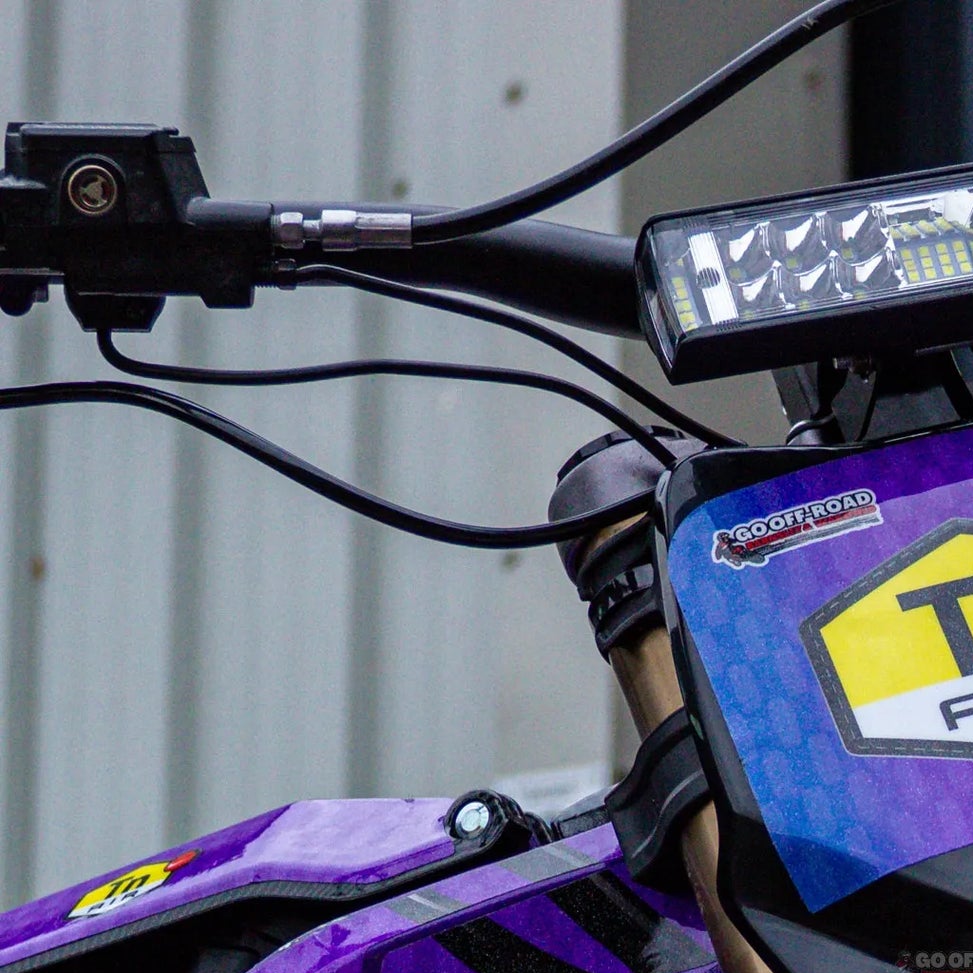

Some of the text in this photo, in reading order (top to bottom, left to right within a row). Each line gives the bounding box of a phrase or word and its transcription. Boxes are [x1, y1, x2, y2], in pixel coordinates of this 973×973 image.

[734, 521, 768, 543] GO
[769, 491, 873, 530] OFF-ROAD
[88, 890, 138, 913] AIR
